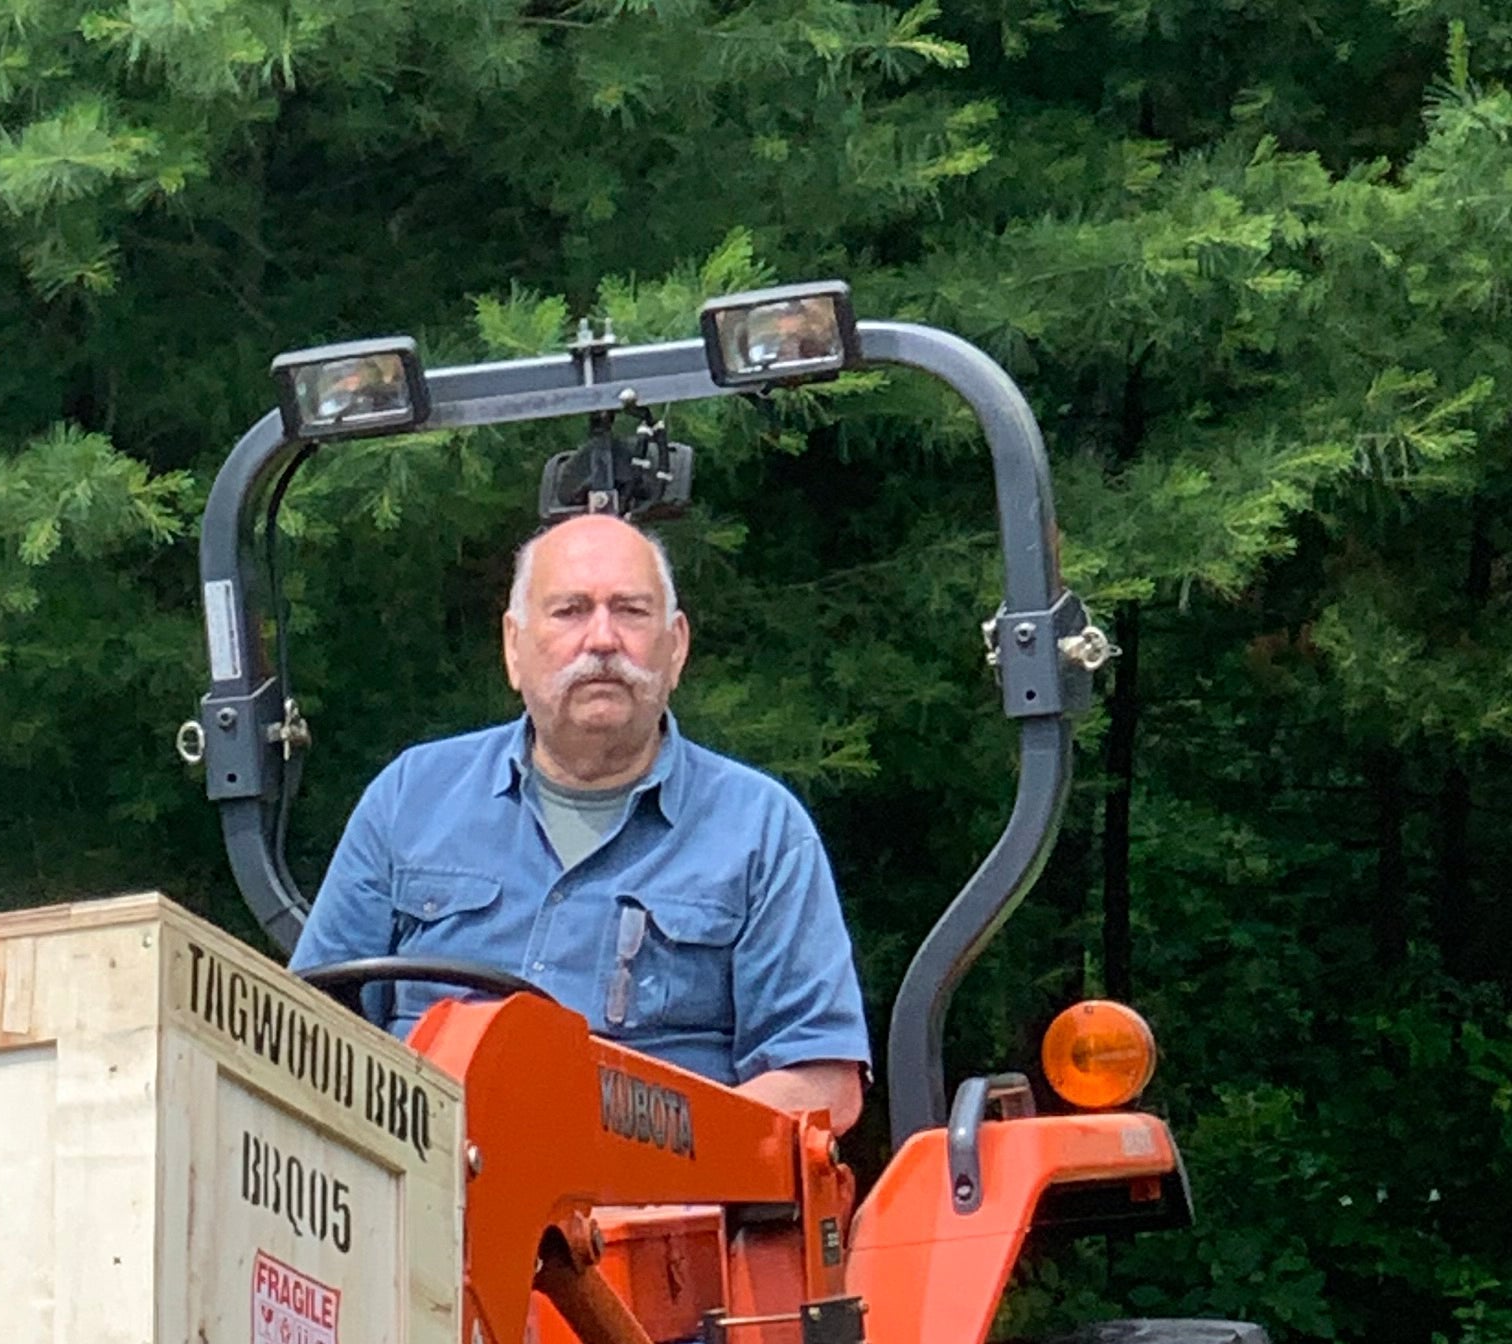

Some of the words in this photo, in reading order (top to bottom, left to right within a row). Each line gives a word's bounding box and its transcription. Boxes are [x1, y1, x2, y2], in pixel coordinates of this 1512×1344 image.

[187, 941, 354, 1110] TAGWOOD
[365, 1055, 431, 1163] BBQ
[598, 1065, 696, 1160] KUBOTA
[241, 1130, 353, 1255] BBQ05
[256, 1262, 334, 1330] FRAGILE
